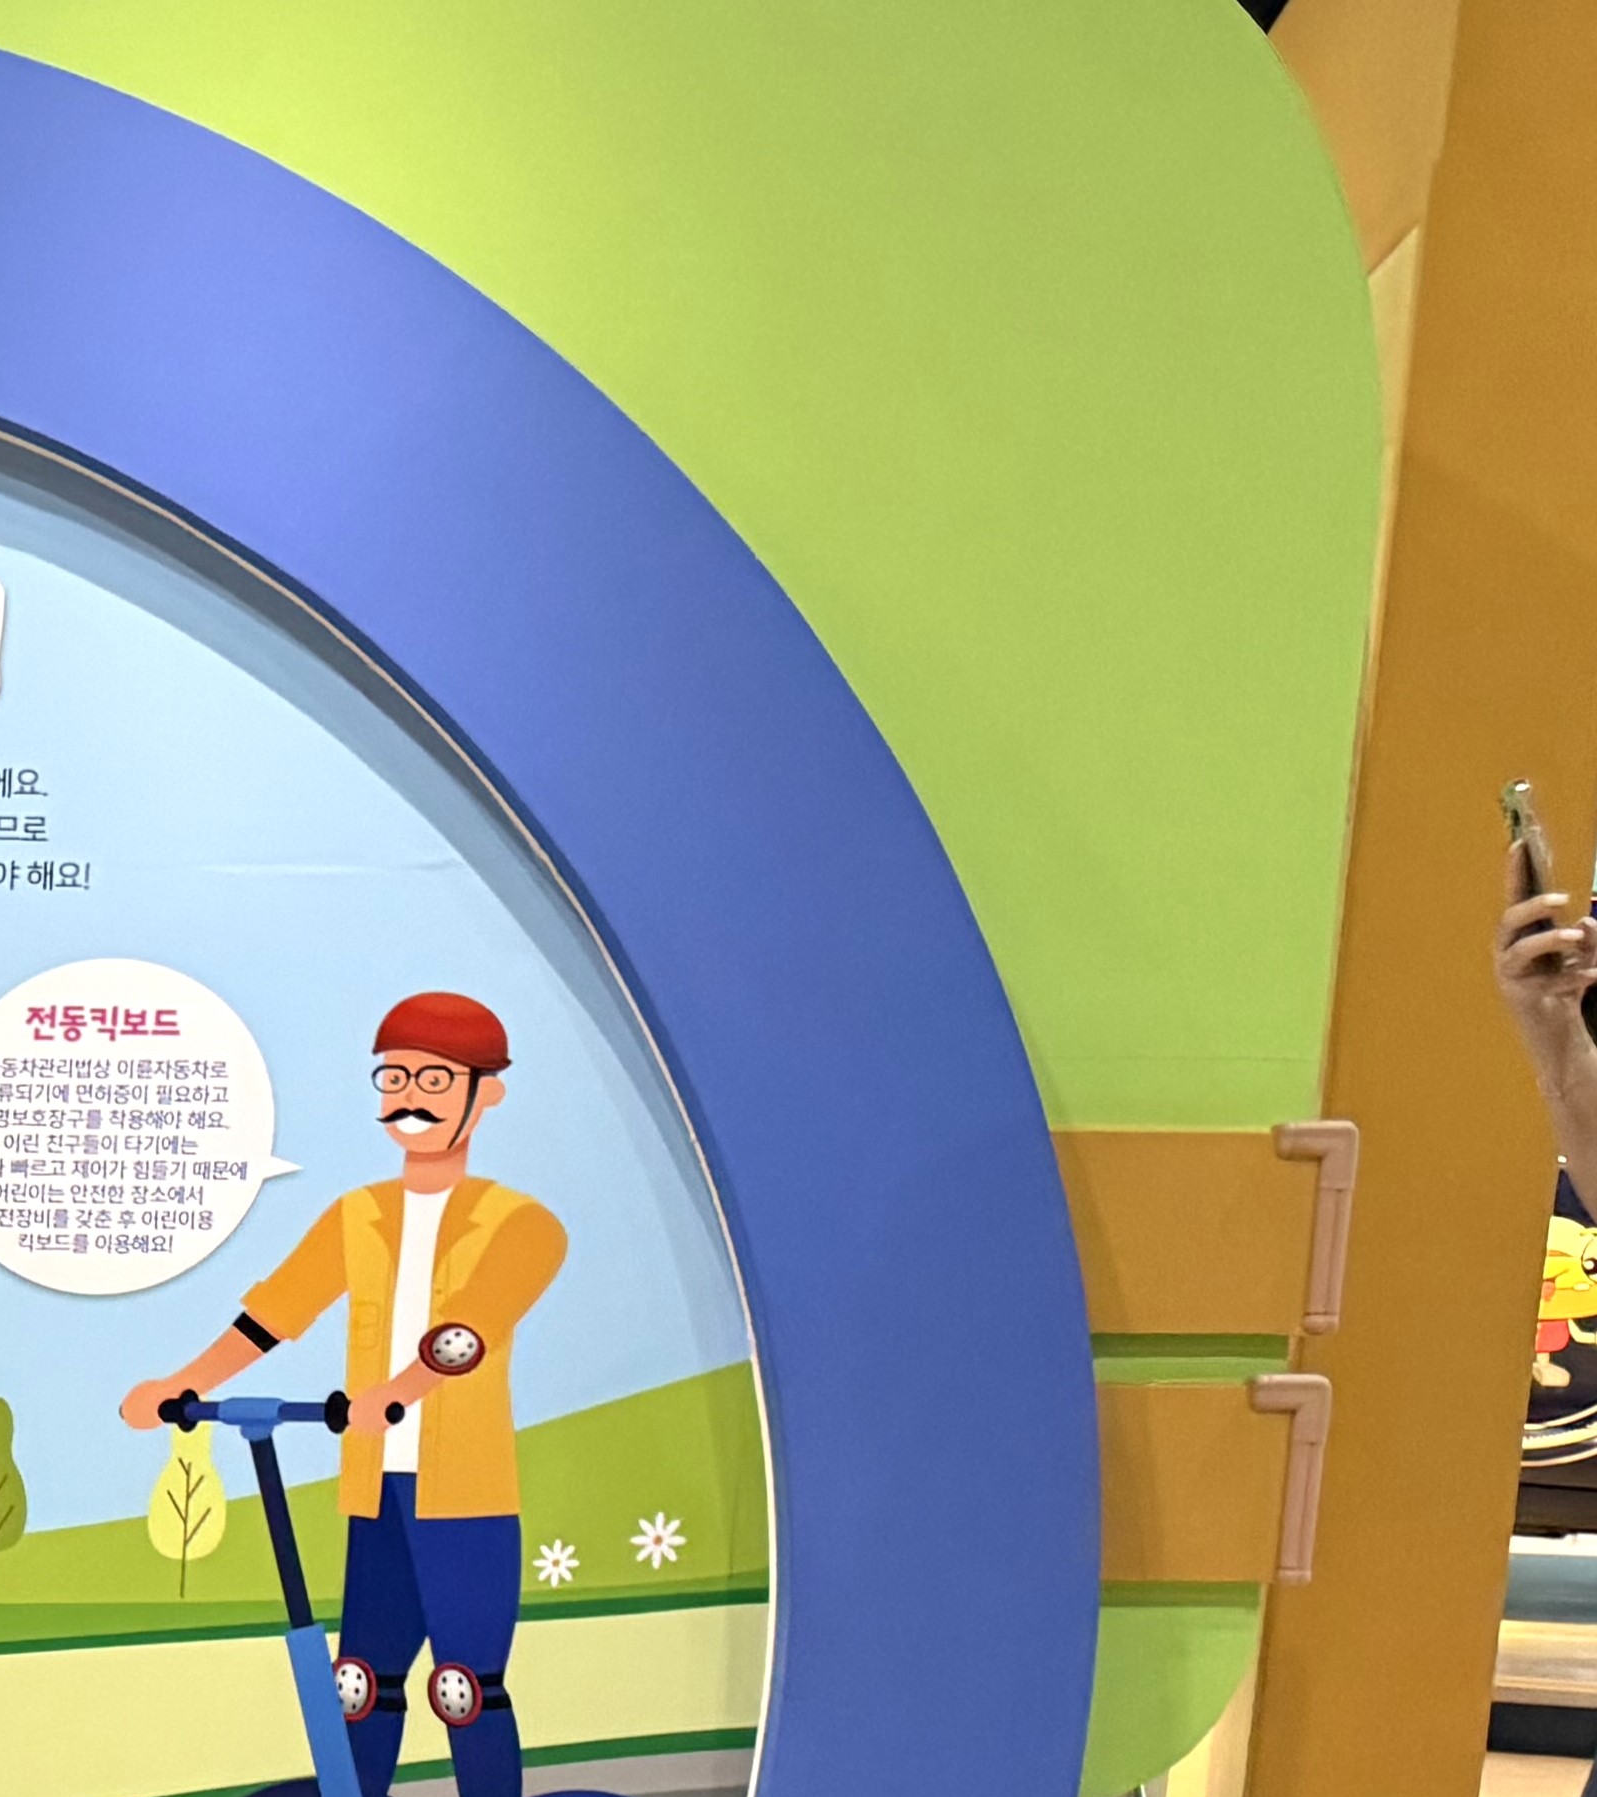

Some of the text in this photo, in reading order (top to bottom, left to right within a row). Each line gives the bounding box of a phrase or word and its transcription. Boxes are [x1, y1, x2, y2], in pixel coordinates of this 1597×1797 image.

[27, 861, 90, 891] 해요!
[26, 1005, 180, 1042] 전동킥보드
[76, 1084, 148, 1105] 면허증이
[156, 1085, 228, 1105] 필요하고
[109, 1110, 182, 1130] 착용해야
[188, 1111, 229, 1129] 해요.
[47, 1134, 118, 1154] 친구들이
[125, 1135, 198, 1155] 타기에는
[11, 1159, 66, 1178] 빠르고
[133, 1160, 186, 1180] 힘들기
[193, 1161, 247, 1180] 때문에
[70, 1184, 124, 1204] 안전한
[131, 1186, 203, 1205] 장소에서
[76, 1209, 112, 1229] 갖춘
[117, 1210, 136, 1229] 후
[141, 1210, 213, 1230] 어린이용
[19, 1234, 173, 1254] 킥보드를 이용해요!
